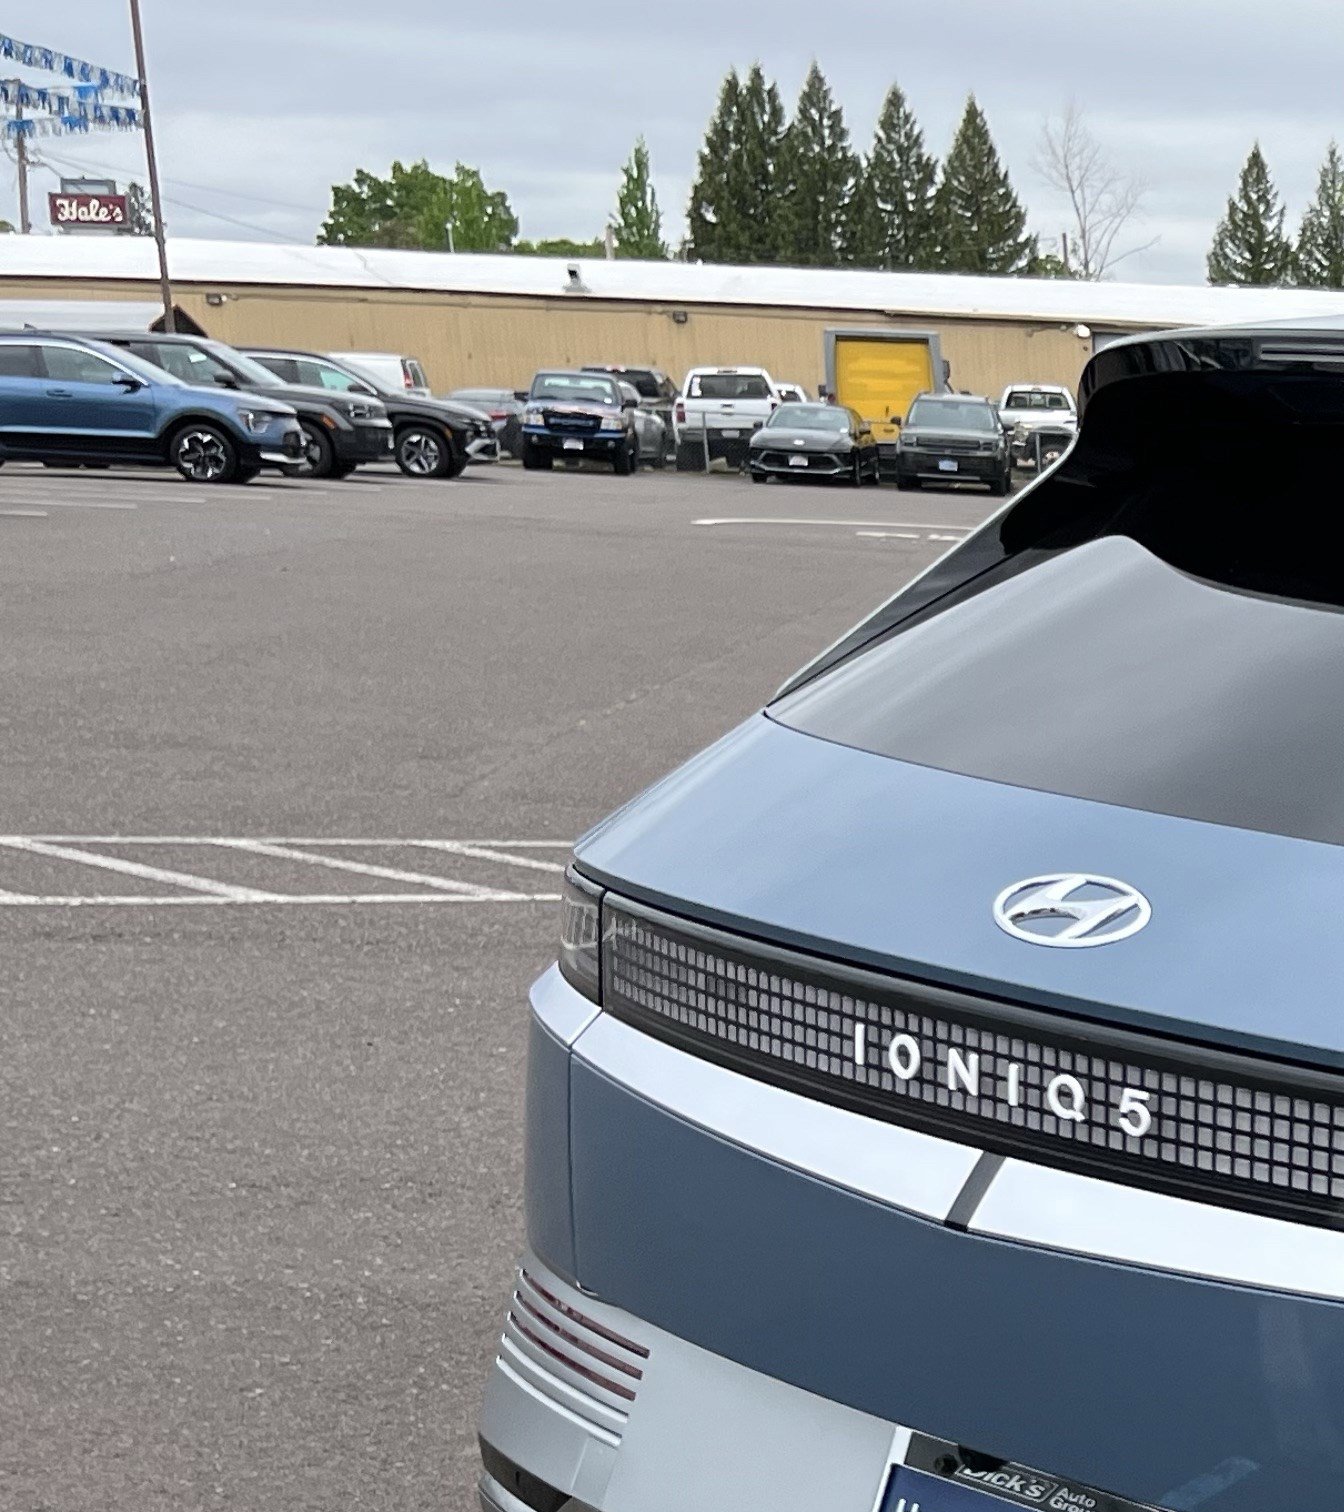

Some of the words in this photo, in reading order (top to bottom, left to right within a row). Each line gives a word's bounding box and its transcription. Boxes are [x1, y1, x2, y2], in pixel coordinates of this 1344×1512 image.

[56, 198, 124, 223] Hale's
[854, 1022, 1086, 1122] IONIQ
[1117, 1087, 1152, 1138] 5
[1055, 1486, 1097, 1509] Auto
